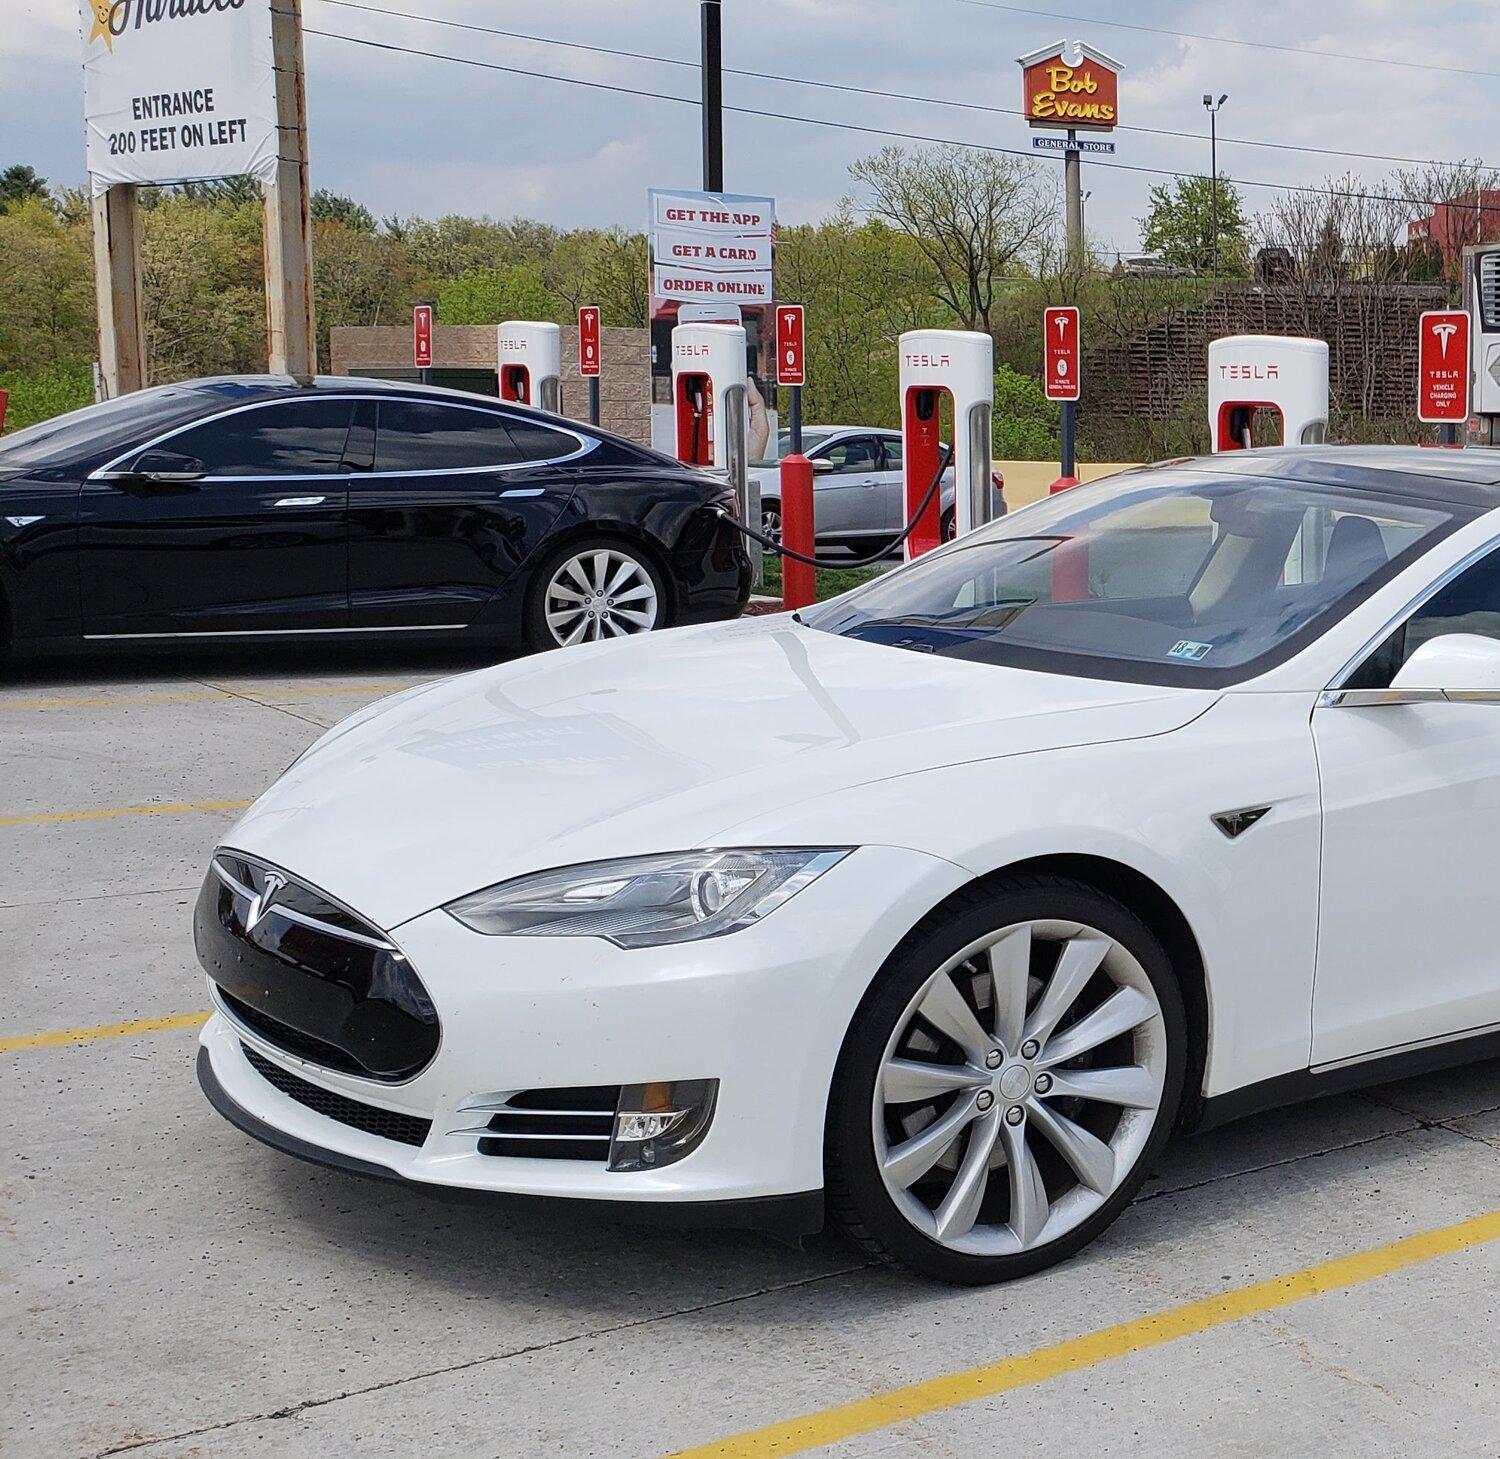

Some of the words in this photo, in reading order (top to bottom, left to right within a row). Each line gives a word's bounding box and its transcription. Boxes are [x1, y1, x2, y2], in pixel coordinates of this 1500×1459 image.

[1045, 65, 1098, 94] Bob
[132, 88, 215, 120] ENTRANCE
[1032, 90, 1115, 120] Evans
[109, 131, 136, 155] 200
[141, 126, 176, 152] FEET
[181, 123, 204, 148] ON
[208, 119, 247, 145] LEFT
[1037, 139, 1081, 149] GENERAL
[1083, 141, 1112, 152] STORE
[666, 208, 696, 221] GET
[699, 210, 730, 224] THE
[732, 213, 761, 226] APP
[672, 245, 702, 257] GET
[705, 246, 716, 258] A
[719, 247, 757, 261] CARD
[663, 279, 714, 293] ORDER
[717, 281, 765, 295] ONLINE
[500, 340, 527, 350] TESLA
[676, 344, 709, 356] TESLA
[905, 355, 950, 367] TESLA
[1219, 365, 1279, 380] TESLA
[1429, 370, 1459, 379] TESLA
[1435, 400, 1451, 408] ONLY
